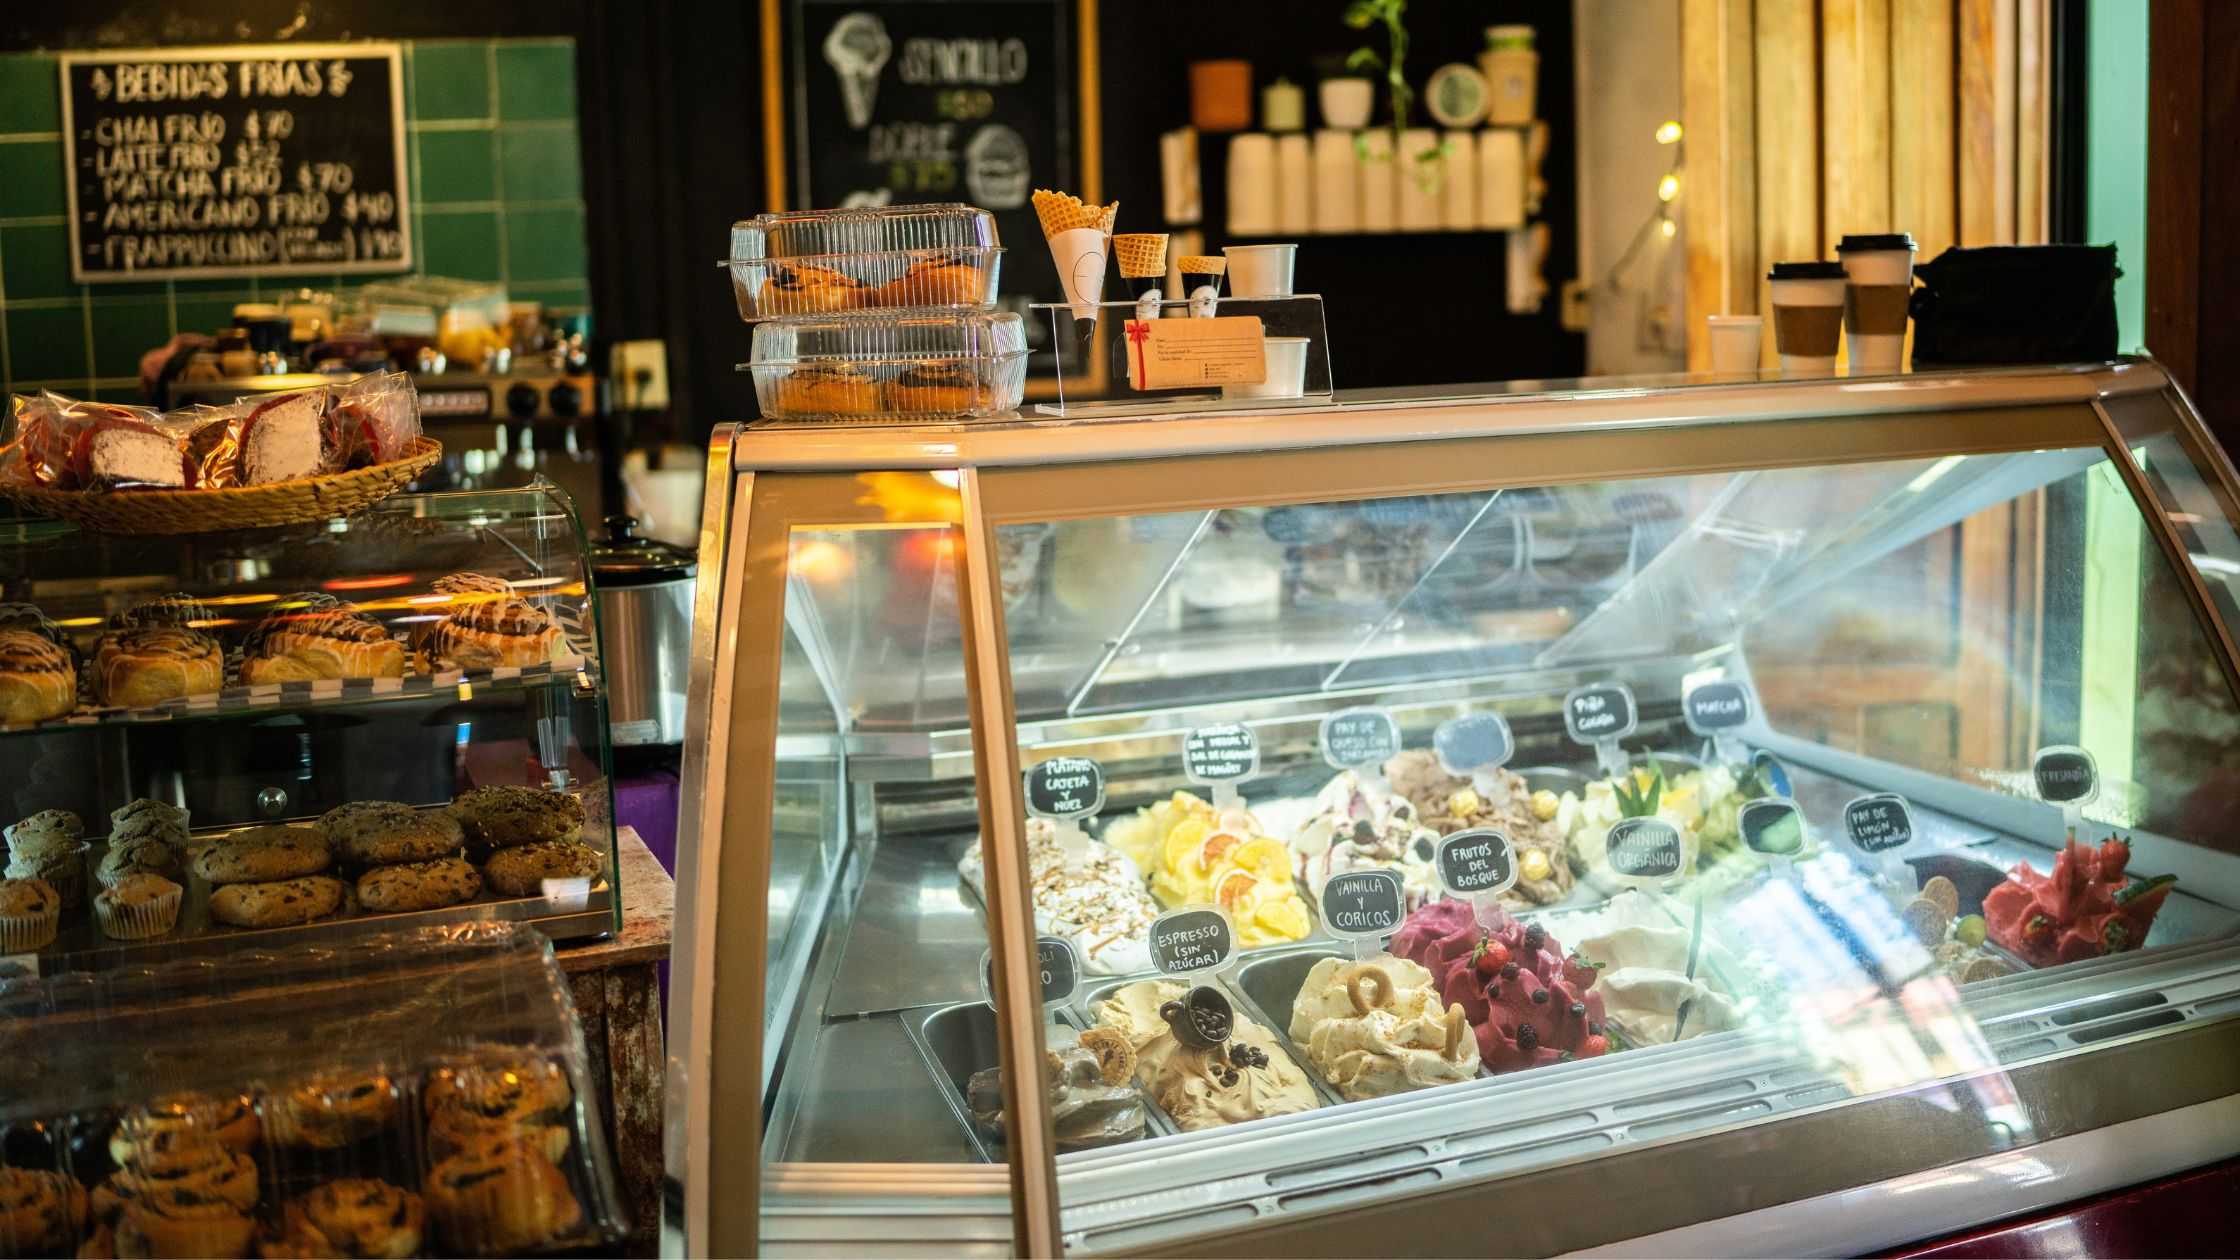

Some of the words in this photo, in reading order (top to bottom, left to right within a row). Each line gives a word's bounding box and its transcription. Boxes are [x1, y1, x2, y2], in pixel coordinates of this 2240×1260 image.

[115, 62, 229, 103] BEBIDAS
[96, 114, 160, 147] CHAI
[95, 143, 167, 178] LATTE
[103, 166, 217, 202] MATCHA
[102, 197, 261, 233] AMERICANO
[1045, 775, 1090, 791] CAJETA
[1060, 790, 1071, 801] Y
[1053, 798, 1083, 813] NUEZ
[1615, 829, 1675, 848] VAINILLA
[1451, 842, 1492, 862] FRUTOS
[1616, 847, 1678, 869] ORGÁNICA
[1468, 859, 1489, 873] DEL
[1335, 878, 1384, 897] VAINILLA
[1456, 869, 1500, 887] BOSQUE
[1356, 896, 1364, 910] Y
[1336, 910, 1392, 927] CORICOS
[1157, 924, 1220, 948] ESPRESSO
[1167, 949, 1219, 971] AZÚCAR)
[1174, 944, 1201, 958] (SIN
